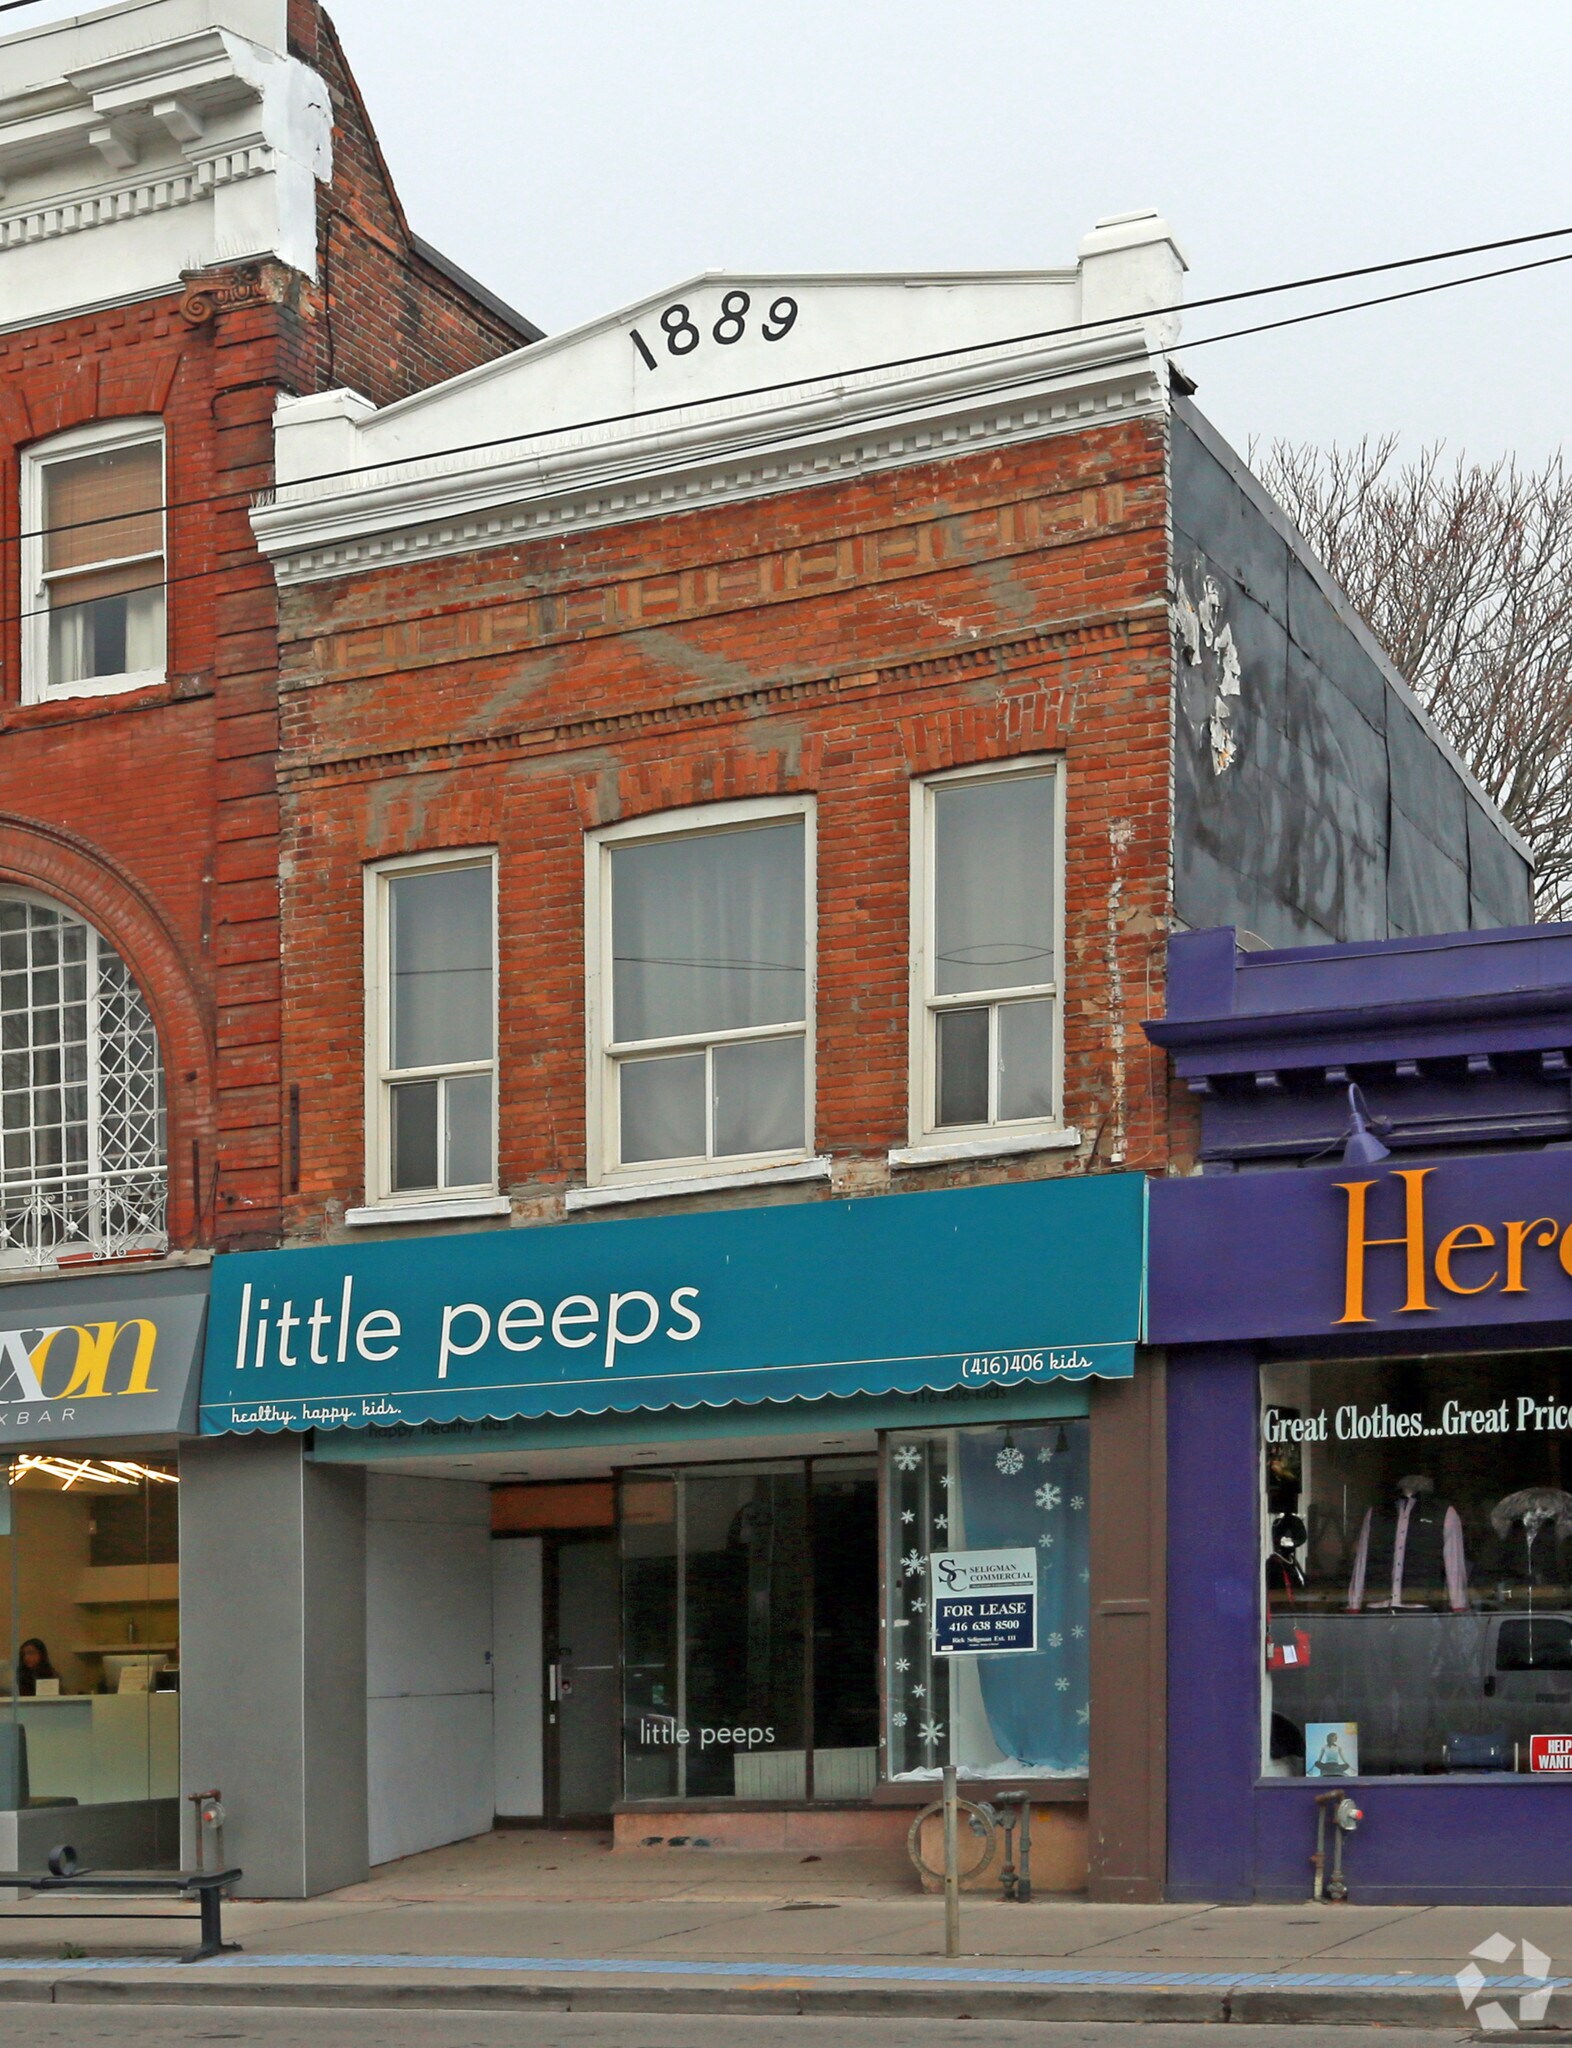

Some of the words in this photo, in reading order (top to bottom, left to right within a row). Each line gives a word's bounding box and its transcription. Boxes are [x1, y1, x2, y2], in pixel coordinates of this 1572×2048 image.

[629, 290, 799, 371] 1889
[1330, 1167, 1572, 1325] Her
[235, 1275, 402, 1370] little
[437, 1286, 702, 1379] peeps
[1050, 1350, 1093, 1370] kids
[231, 1405, 297, 1426] healthy.
[302, 1403, 356, 1423] happy.
[362, 1399, 402, 1416] kids.
[369, 1423, 415, 1439] happy
[421, 1420, 474, 1436] healthy
[481, 1417, 508, 1432] kids
[1263, 1408, 1328, 1443] Great
[969, 1564, 1017, 1574] SELIGMAN
[970, 1572, 1033, 1582] COMMERCIAL
[943, 1605, 974, 1617] FOR
[979, 1602, 1027, 1616] LEASE
[949, 1622, 968, 1632] 416
[972, 1621, 991, 1631] 638
[995, 1619, 1020, 1630] 8500
[640, 1718, 690, 1744] little
[700, 1726, 775, 1750] peeps
[1548, 1739, 1572, 1754] HELP
